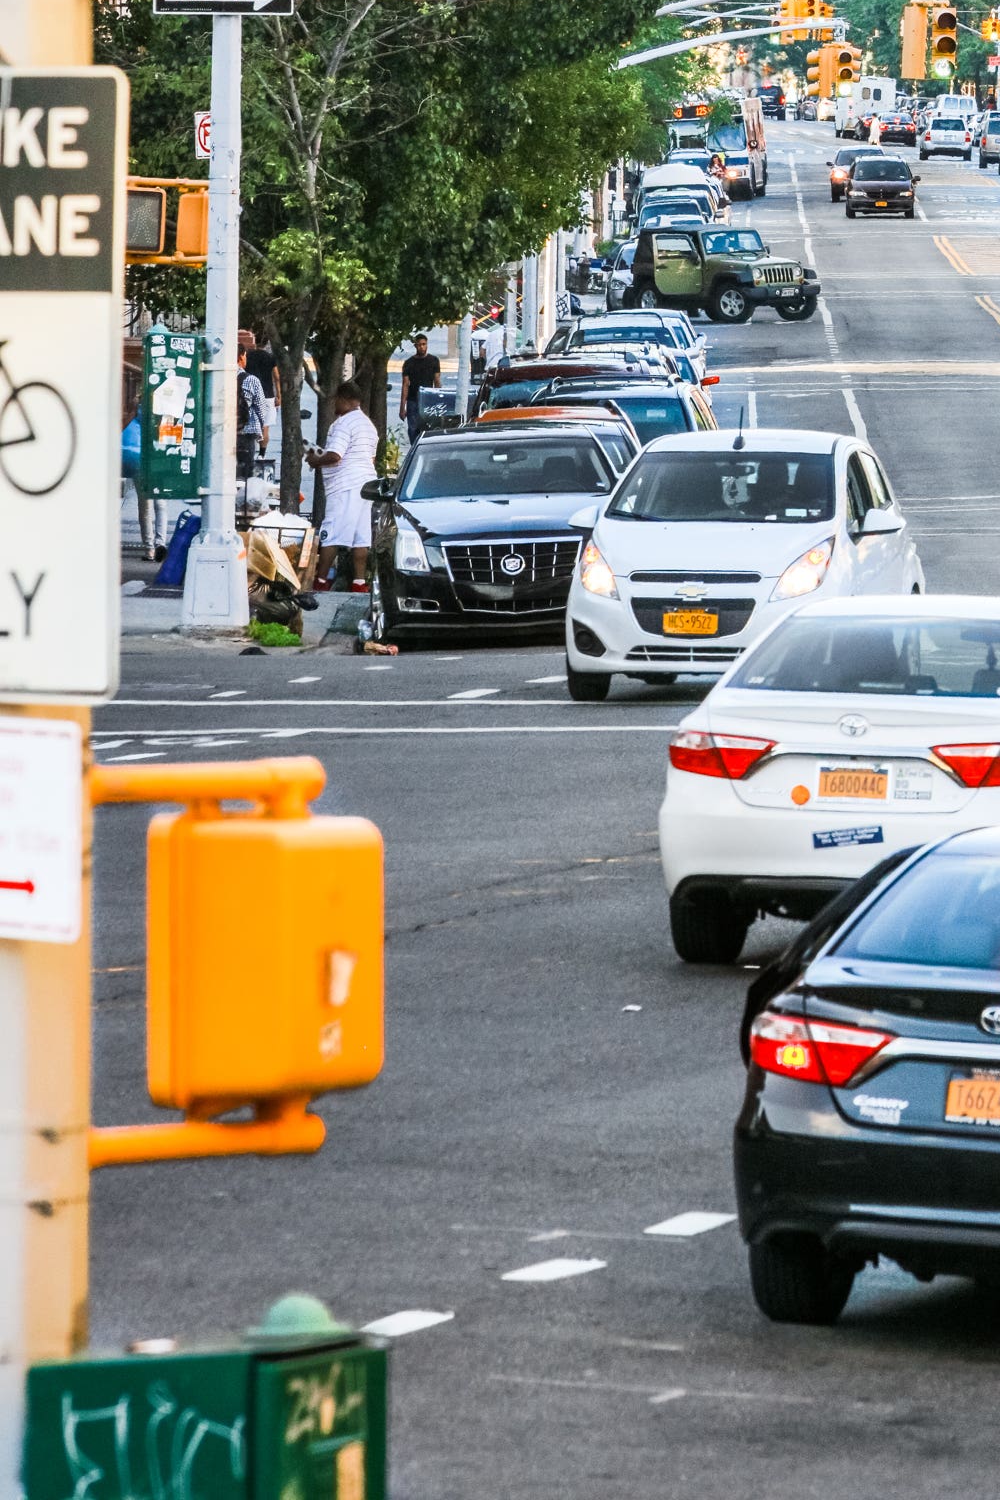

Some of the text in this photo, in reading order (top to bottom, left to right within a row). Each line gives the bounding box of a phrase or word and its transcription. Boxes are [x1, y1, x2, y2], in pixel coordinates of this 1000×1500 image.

[0, 107, 89, 169] KE
[0, 570, 45, 639] Y
[823, 774, 884, 795] T680044C
